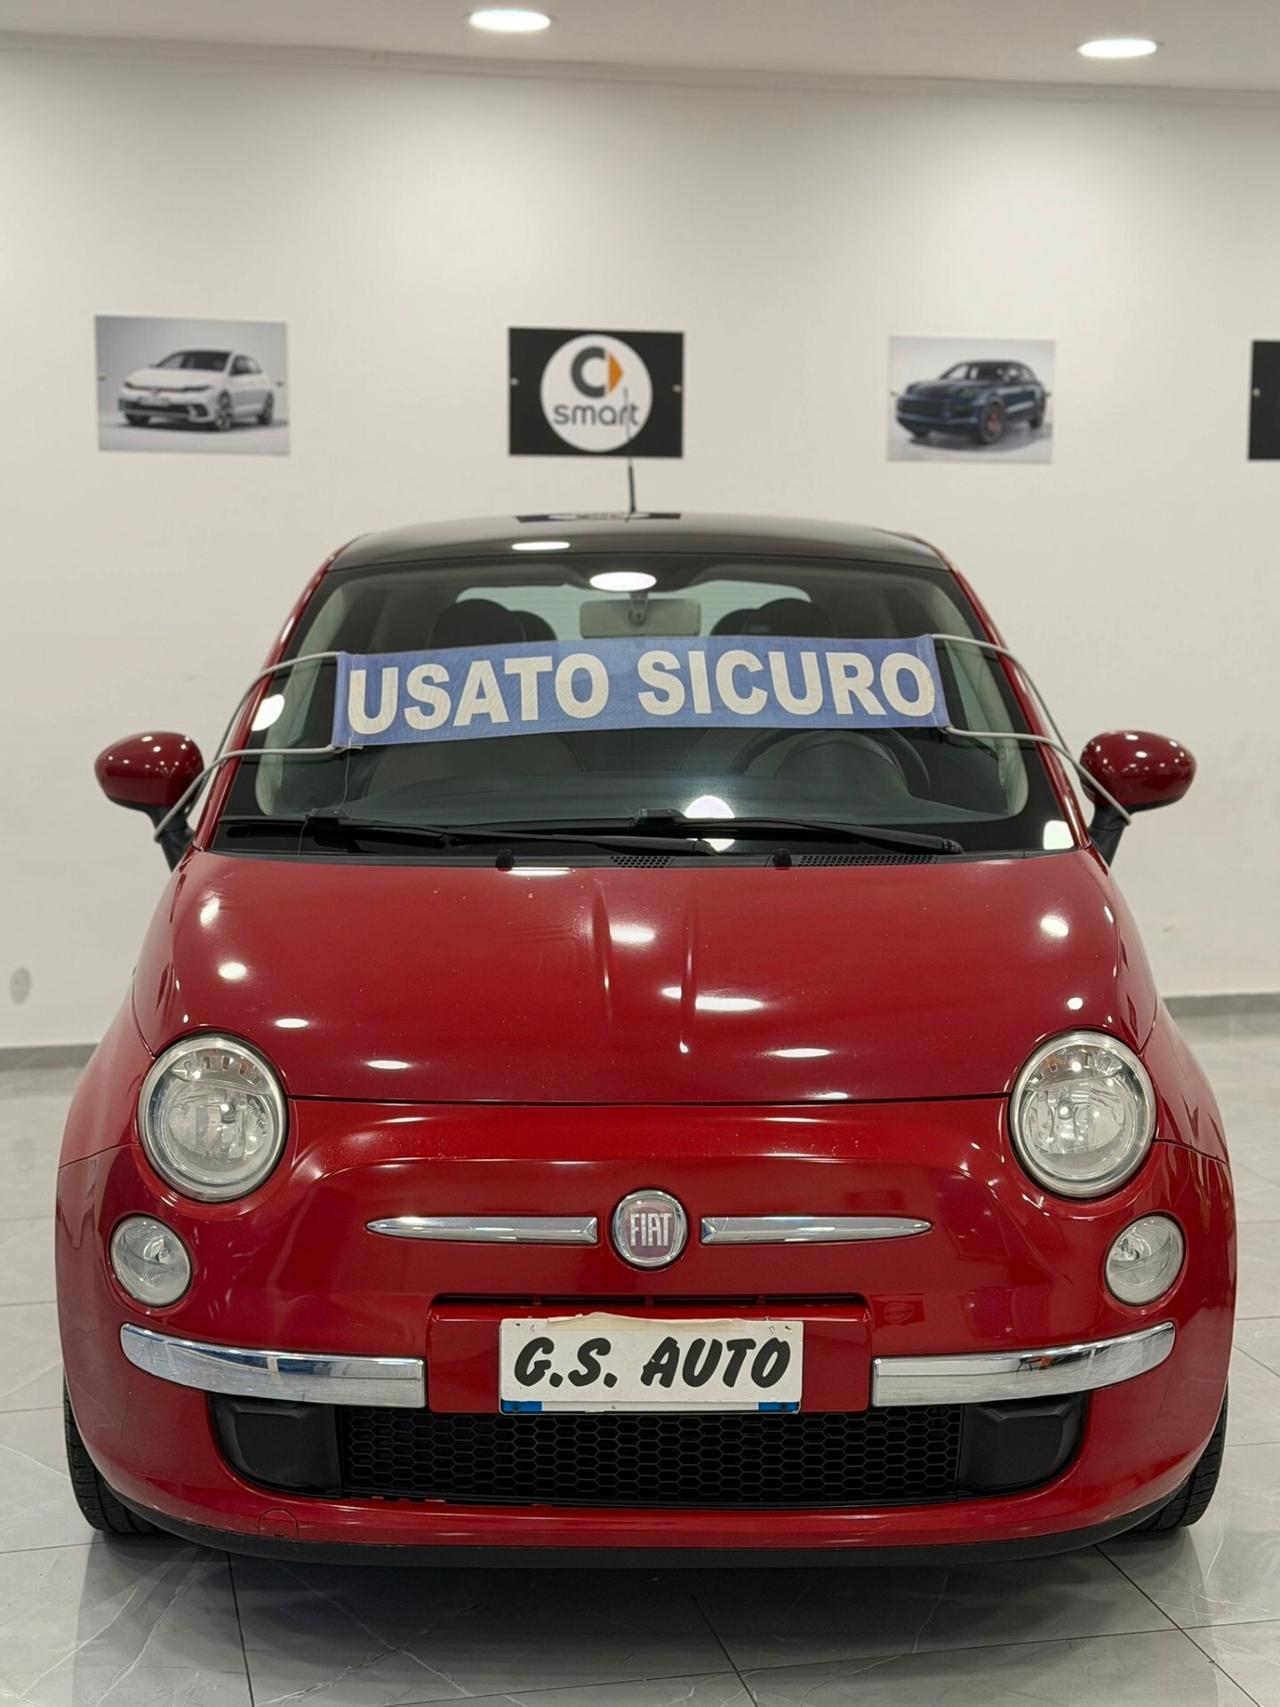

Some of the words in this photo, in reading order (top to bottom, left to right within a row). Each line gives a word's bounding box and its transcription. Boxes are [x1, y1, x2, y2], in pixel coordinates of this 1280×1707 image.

[553, 403, 639, 426] smart
[347, 652, 610, 735] USATO
[637, 649, 936, 718] SICURO
[630, 1212, 672, 1247] FIAT
[514, 1336, 618, 1388] G.S.
[640, 1336, 791, 1388] AUTO
